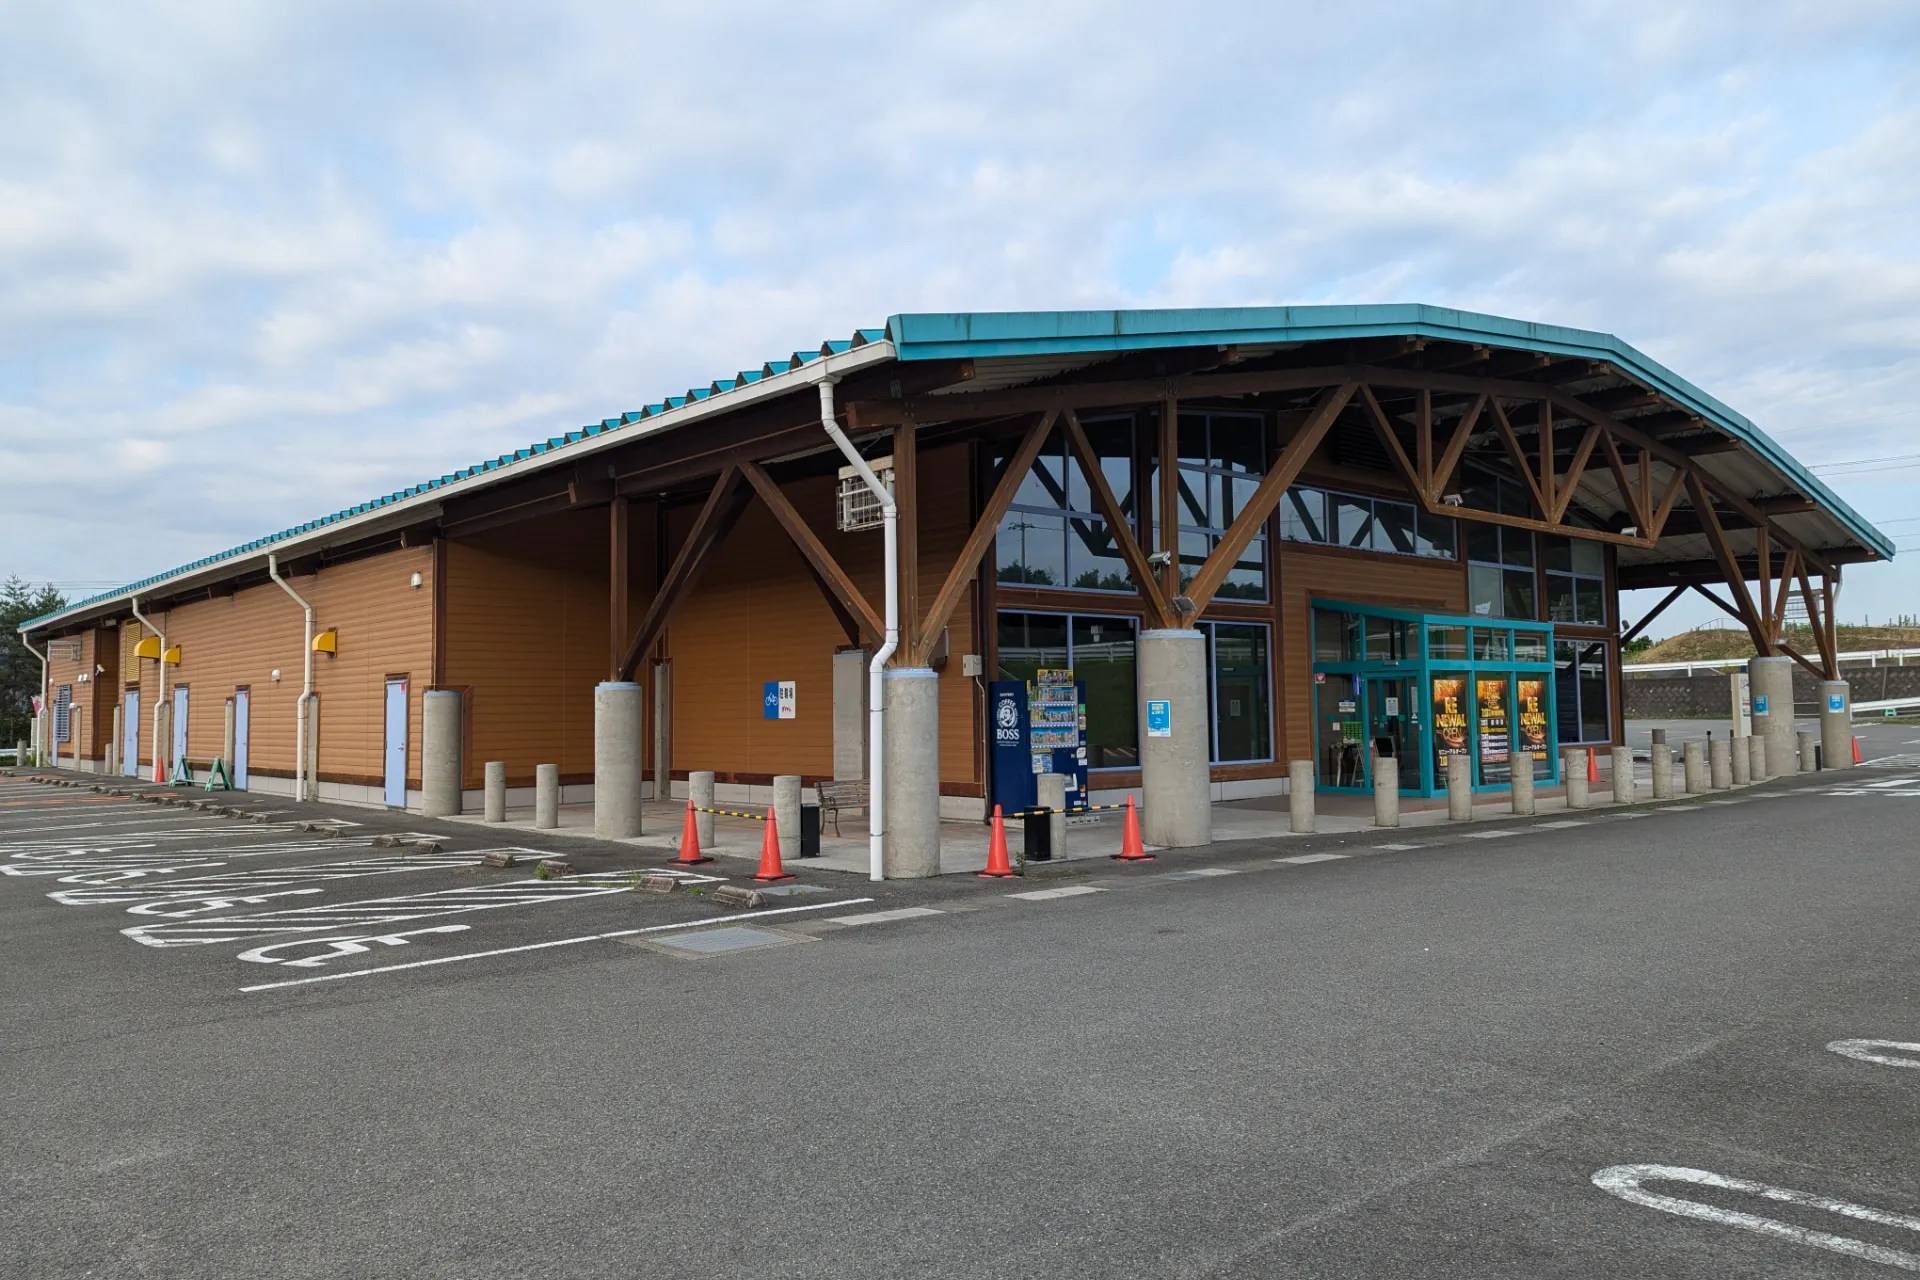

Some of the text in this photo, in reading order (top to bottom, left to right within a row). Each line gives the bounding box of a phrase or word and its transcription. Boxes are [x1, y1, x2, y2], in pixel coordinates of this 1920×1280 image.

[998, 699, 1016, 708] COFFEE
[1444, 697, 1457, 713] RE
[1527, 697, 1538, 712] RE
[1436, 714, 1466, 727] NEWAL
[1520, 713, 1546, 725] NEWAL
[996, 729, 1019, 740] BOSS
[1443, 728, 1461, 738] OPEN
